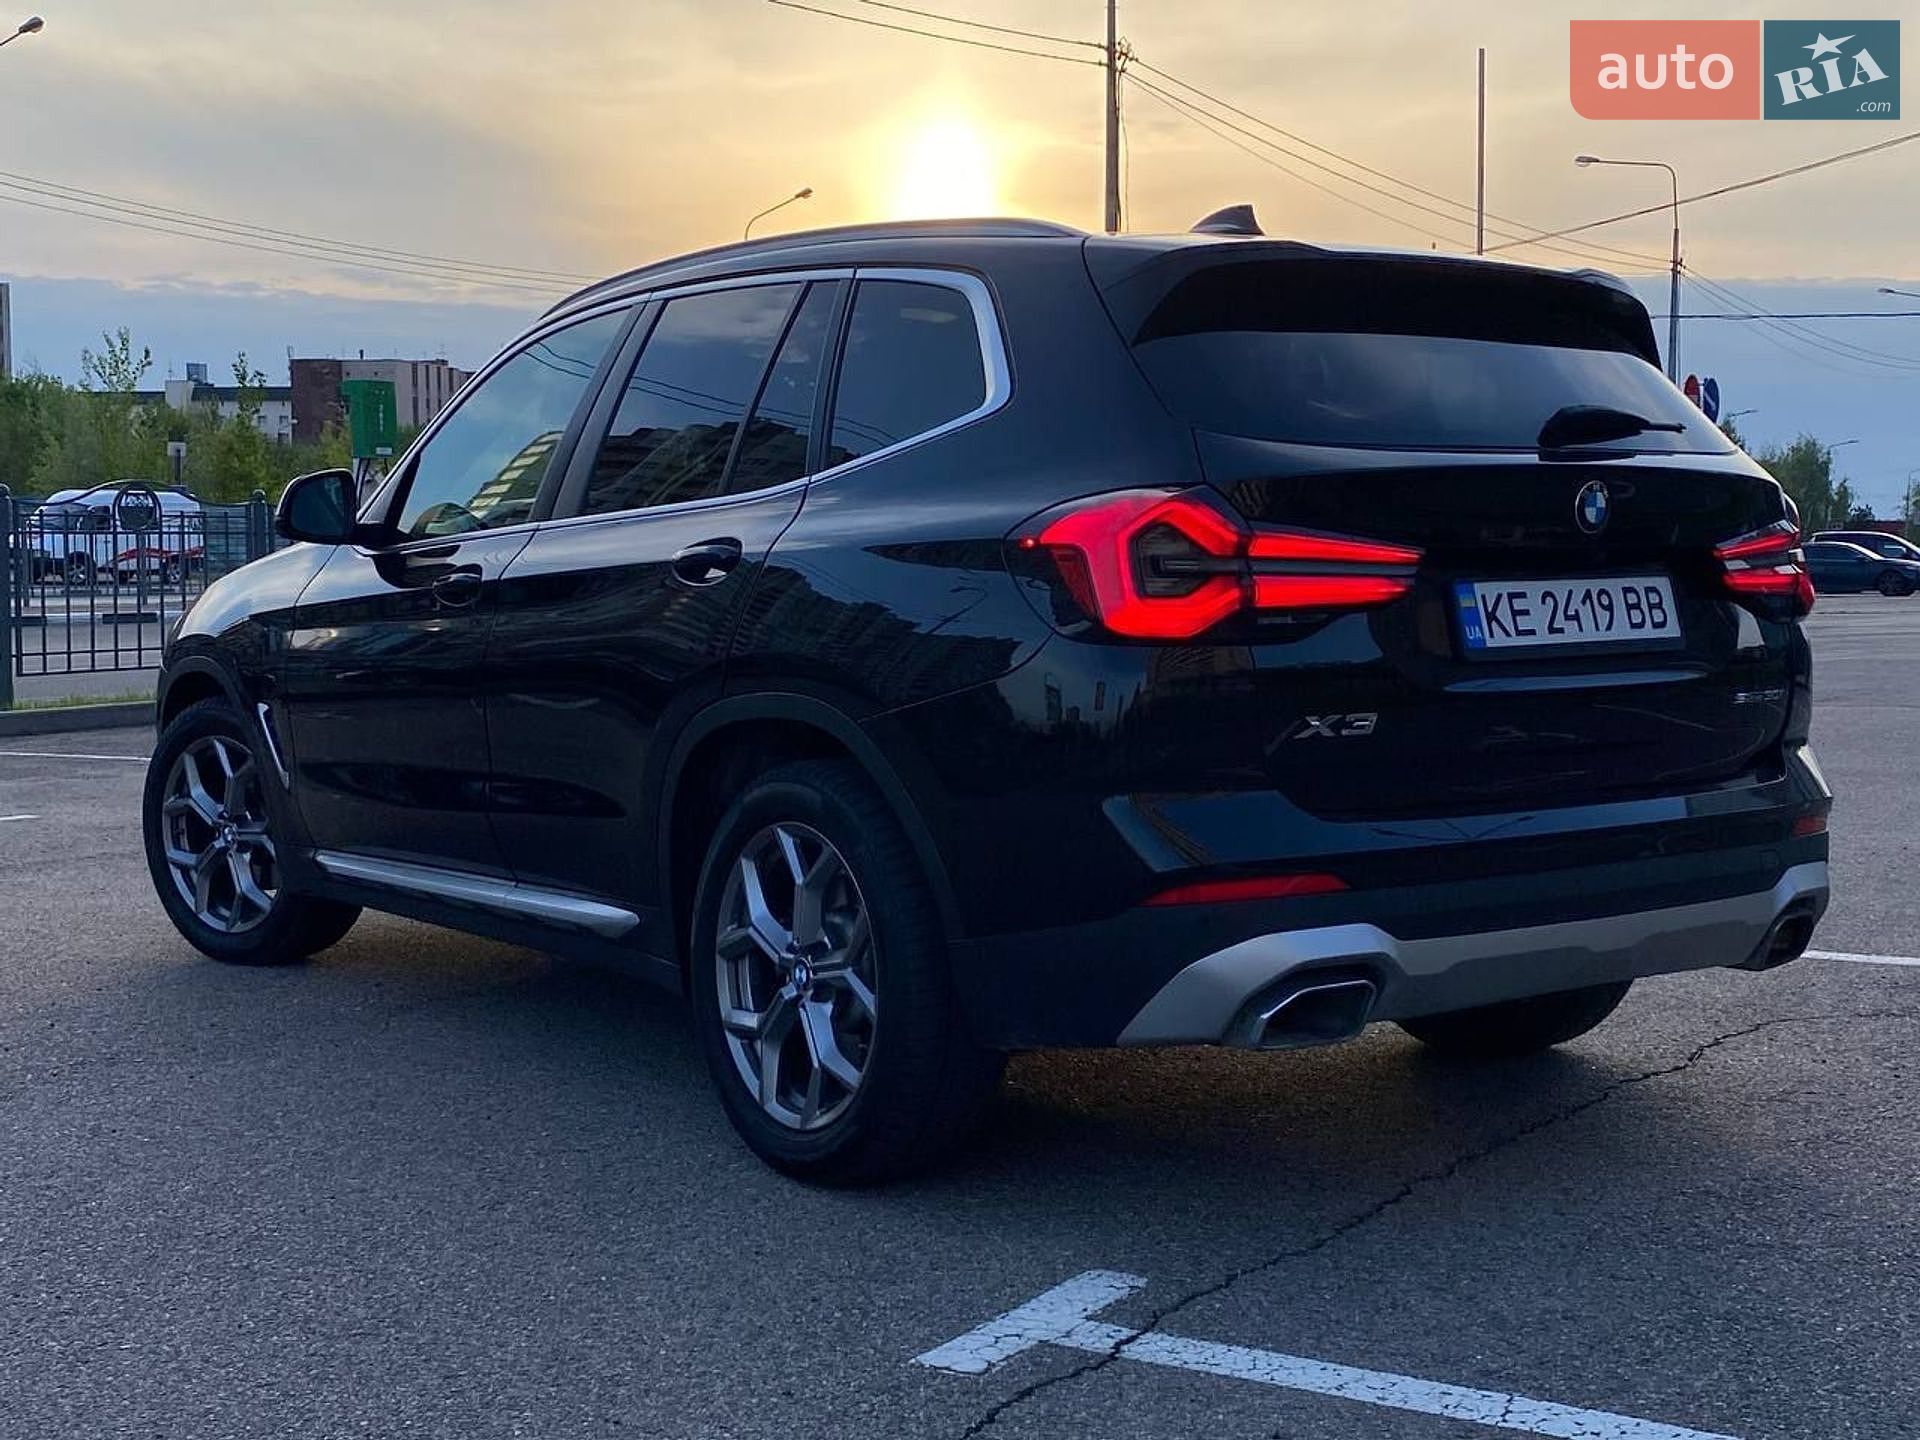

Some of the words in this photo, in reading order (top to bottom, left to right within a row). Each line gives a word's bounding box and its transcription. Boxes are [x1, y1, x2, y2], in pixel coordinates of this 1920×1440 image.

[1481, 591, 1537, 638] KE
[1541, 588, 1614, 635] 2419
[1621, 586, 1668, 630] BB
[1465, 626, 1484, 640] UA
[1294, 712, 1378, 739] X3
